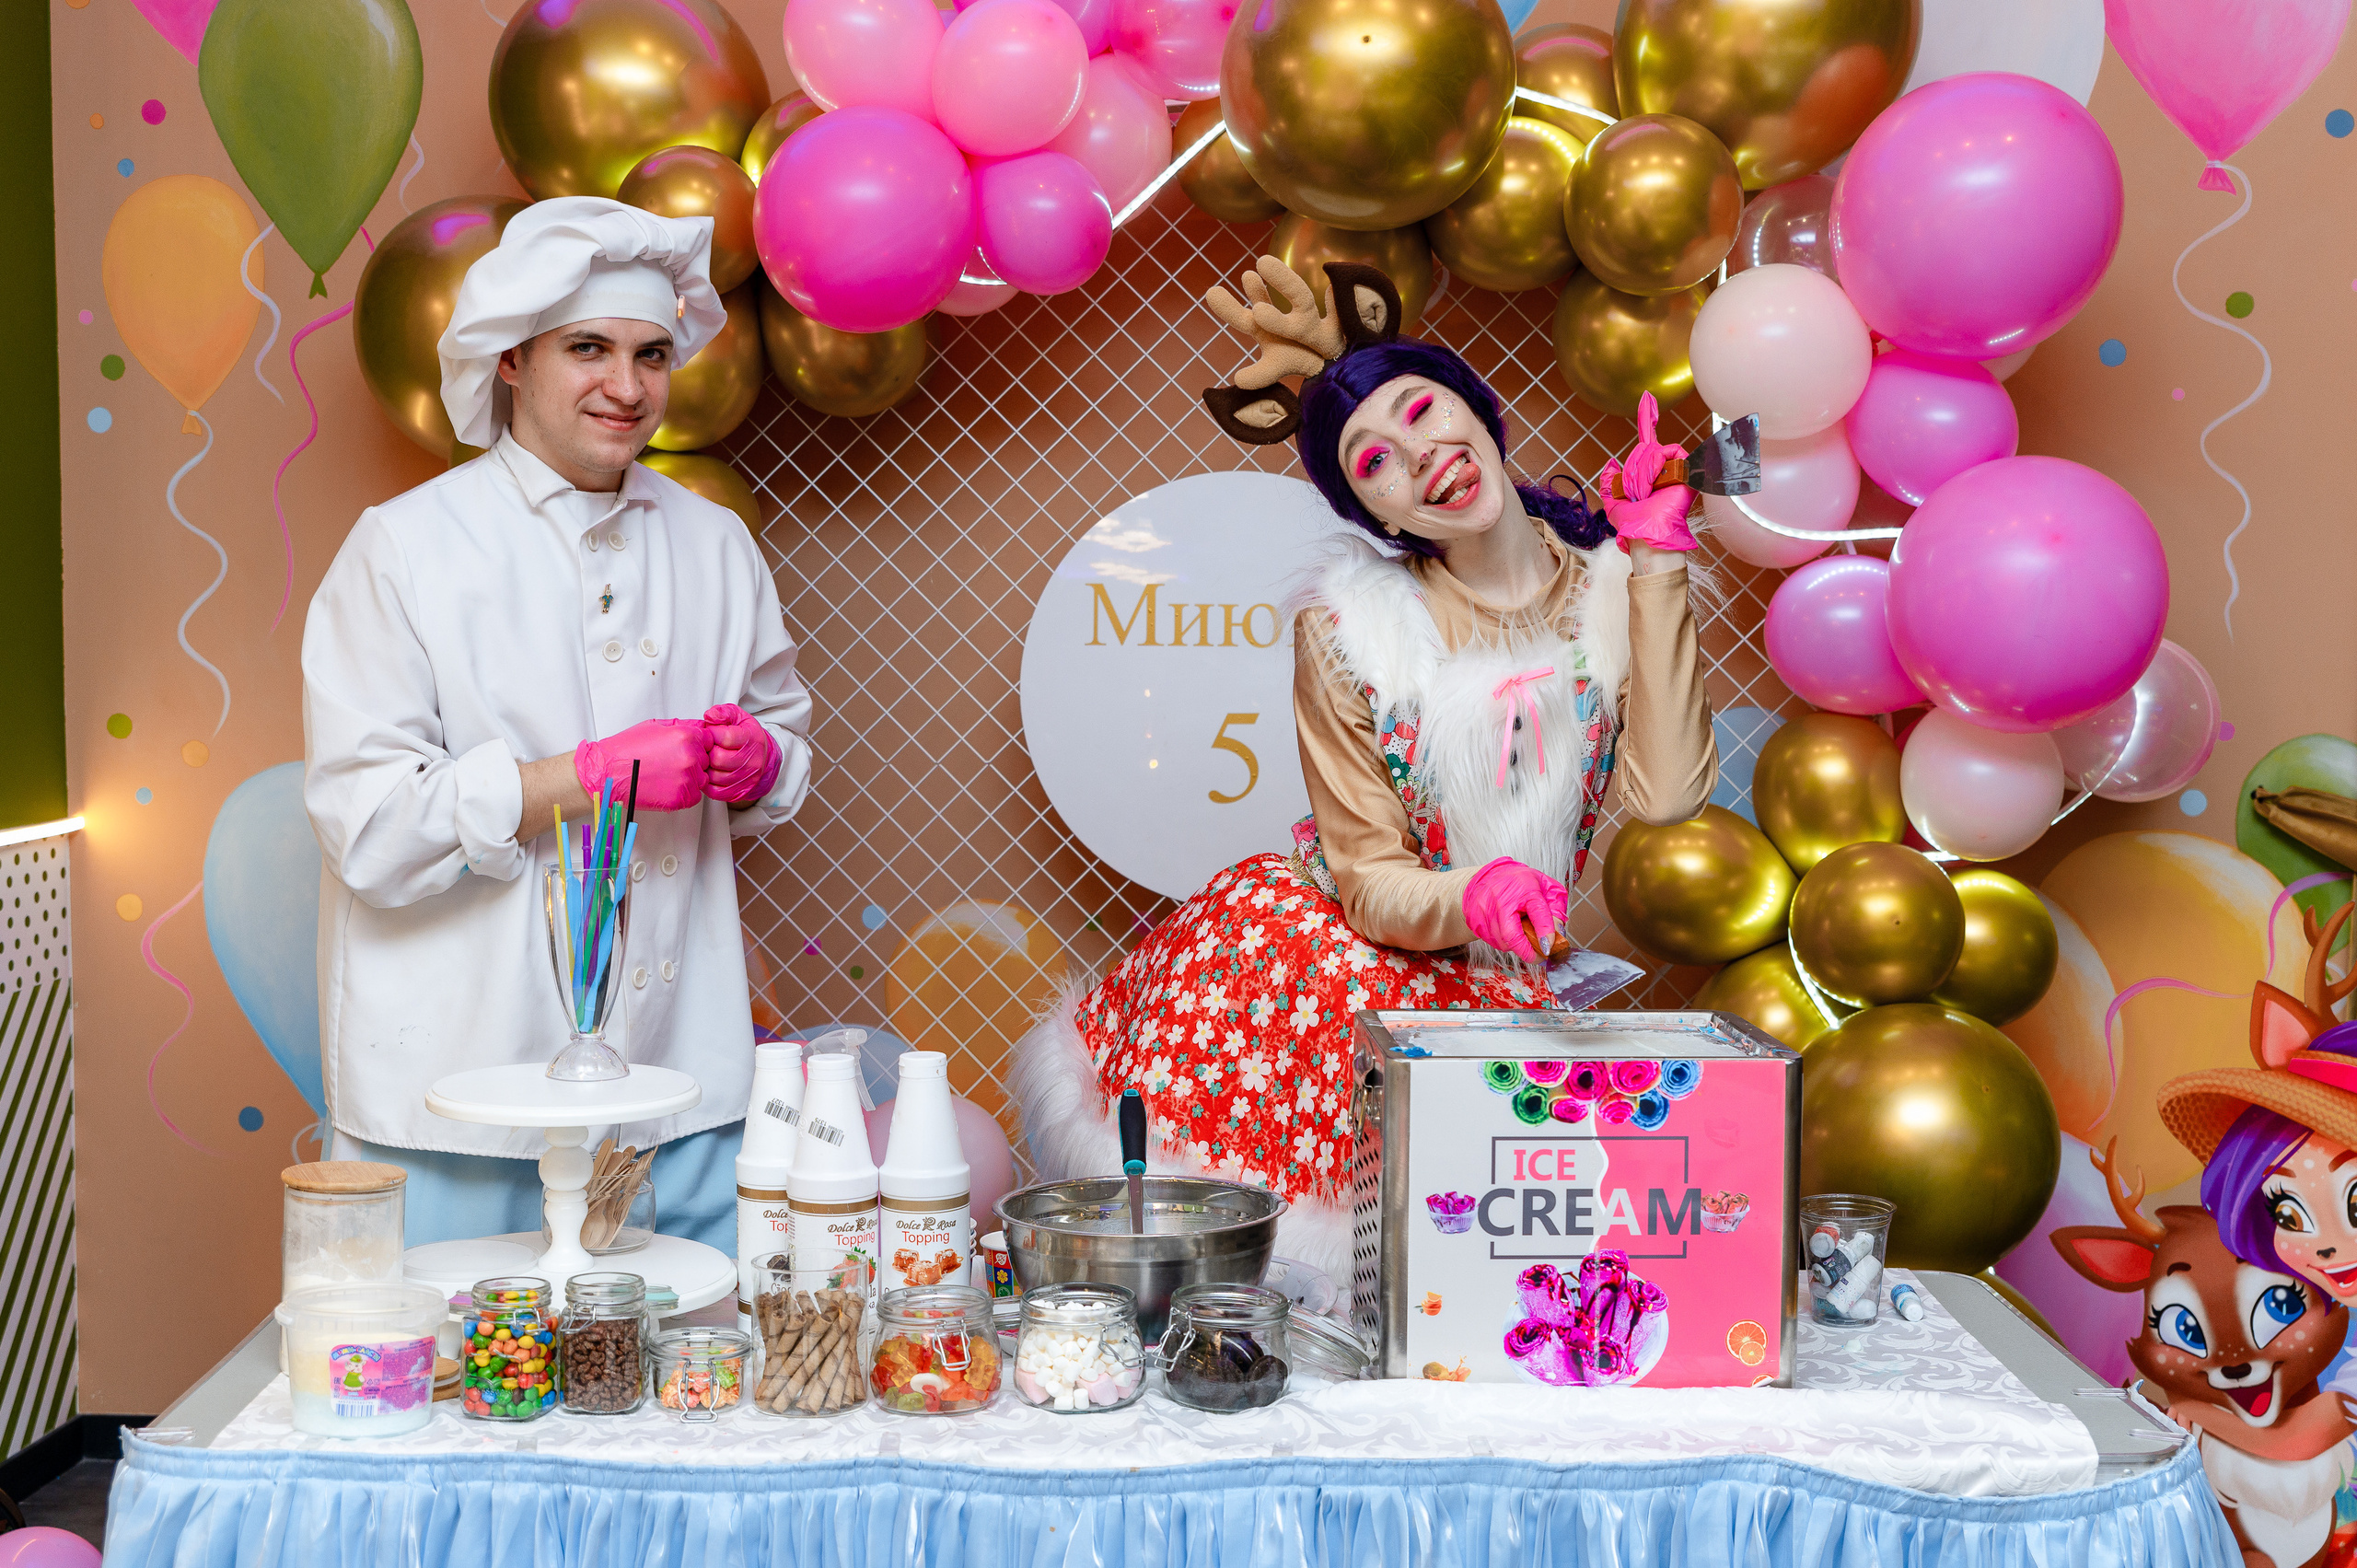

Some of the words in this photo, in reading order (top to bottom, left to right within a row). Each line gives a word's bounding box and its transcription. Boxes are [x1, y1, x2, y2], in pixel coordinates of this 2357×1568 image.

[1085, 583, 1295, 649] Мию
[1208, 712, 1260, 805] 5
[1513, 1148, 1576, 1182] ICE
[1477, 1186, 1701, 1237] CREAM
[827, 1222, 854, 1233] Dolce
[895, 1220, 922, 1230] Dolce
[935, 1219, 957, 1231] Rosa
[834, 1231, 876, 1248] Topping
[901, 1230, 950, 1246] Topping
